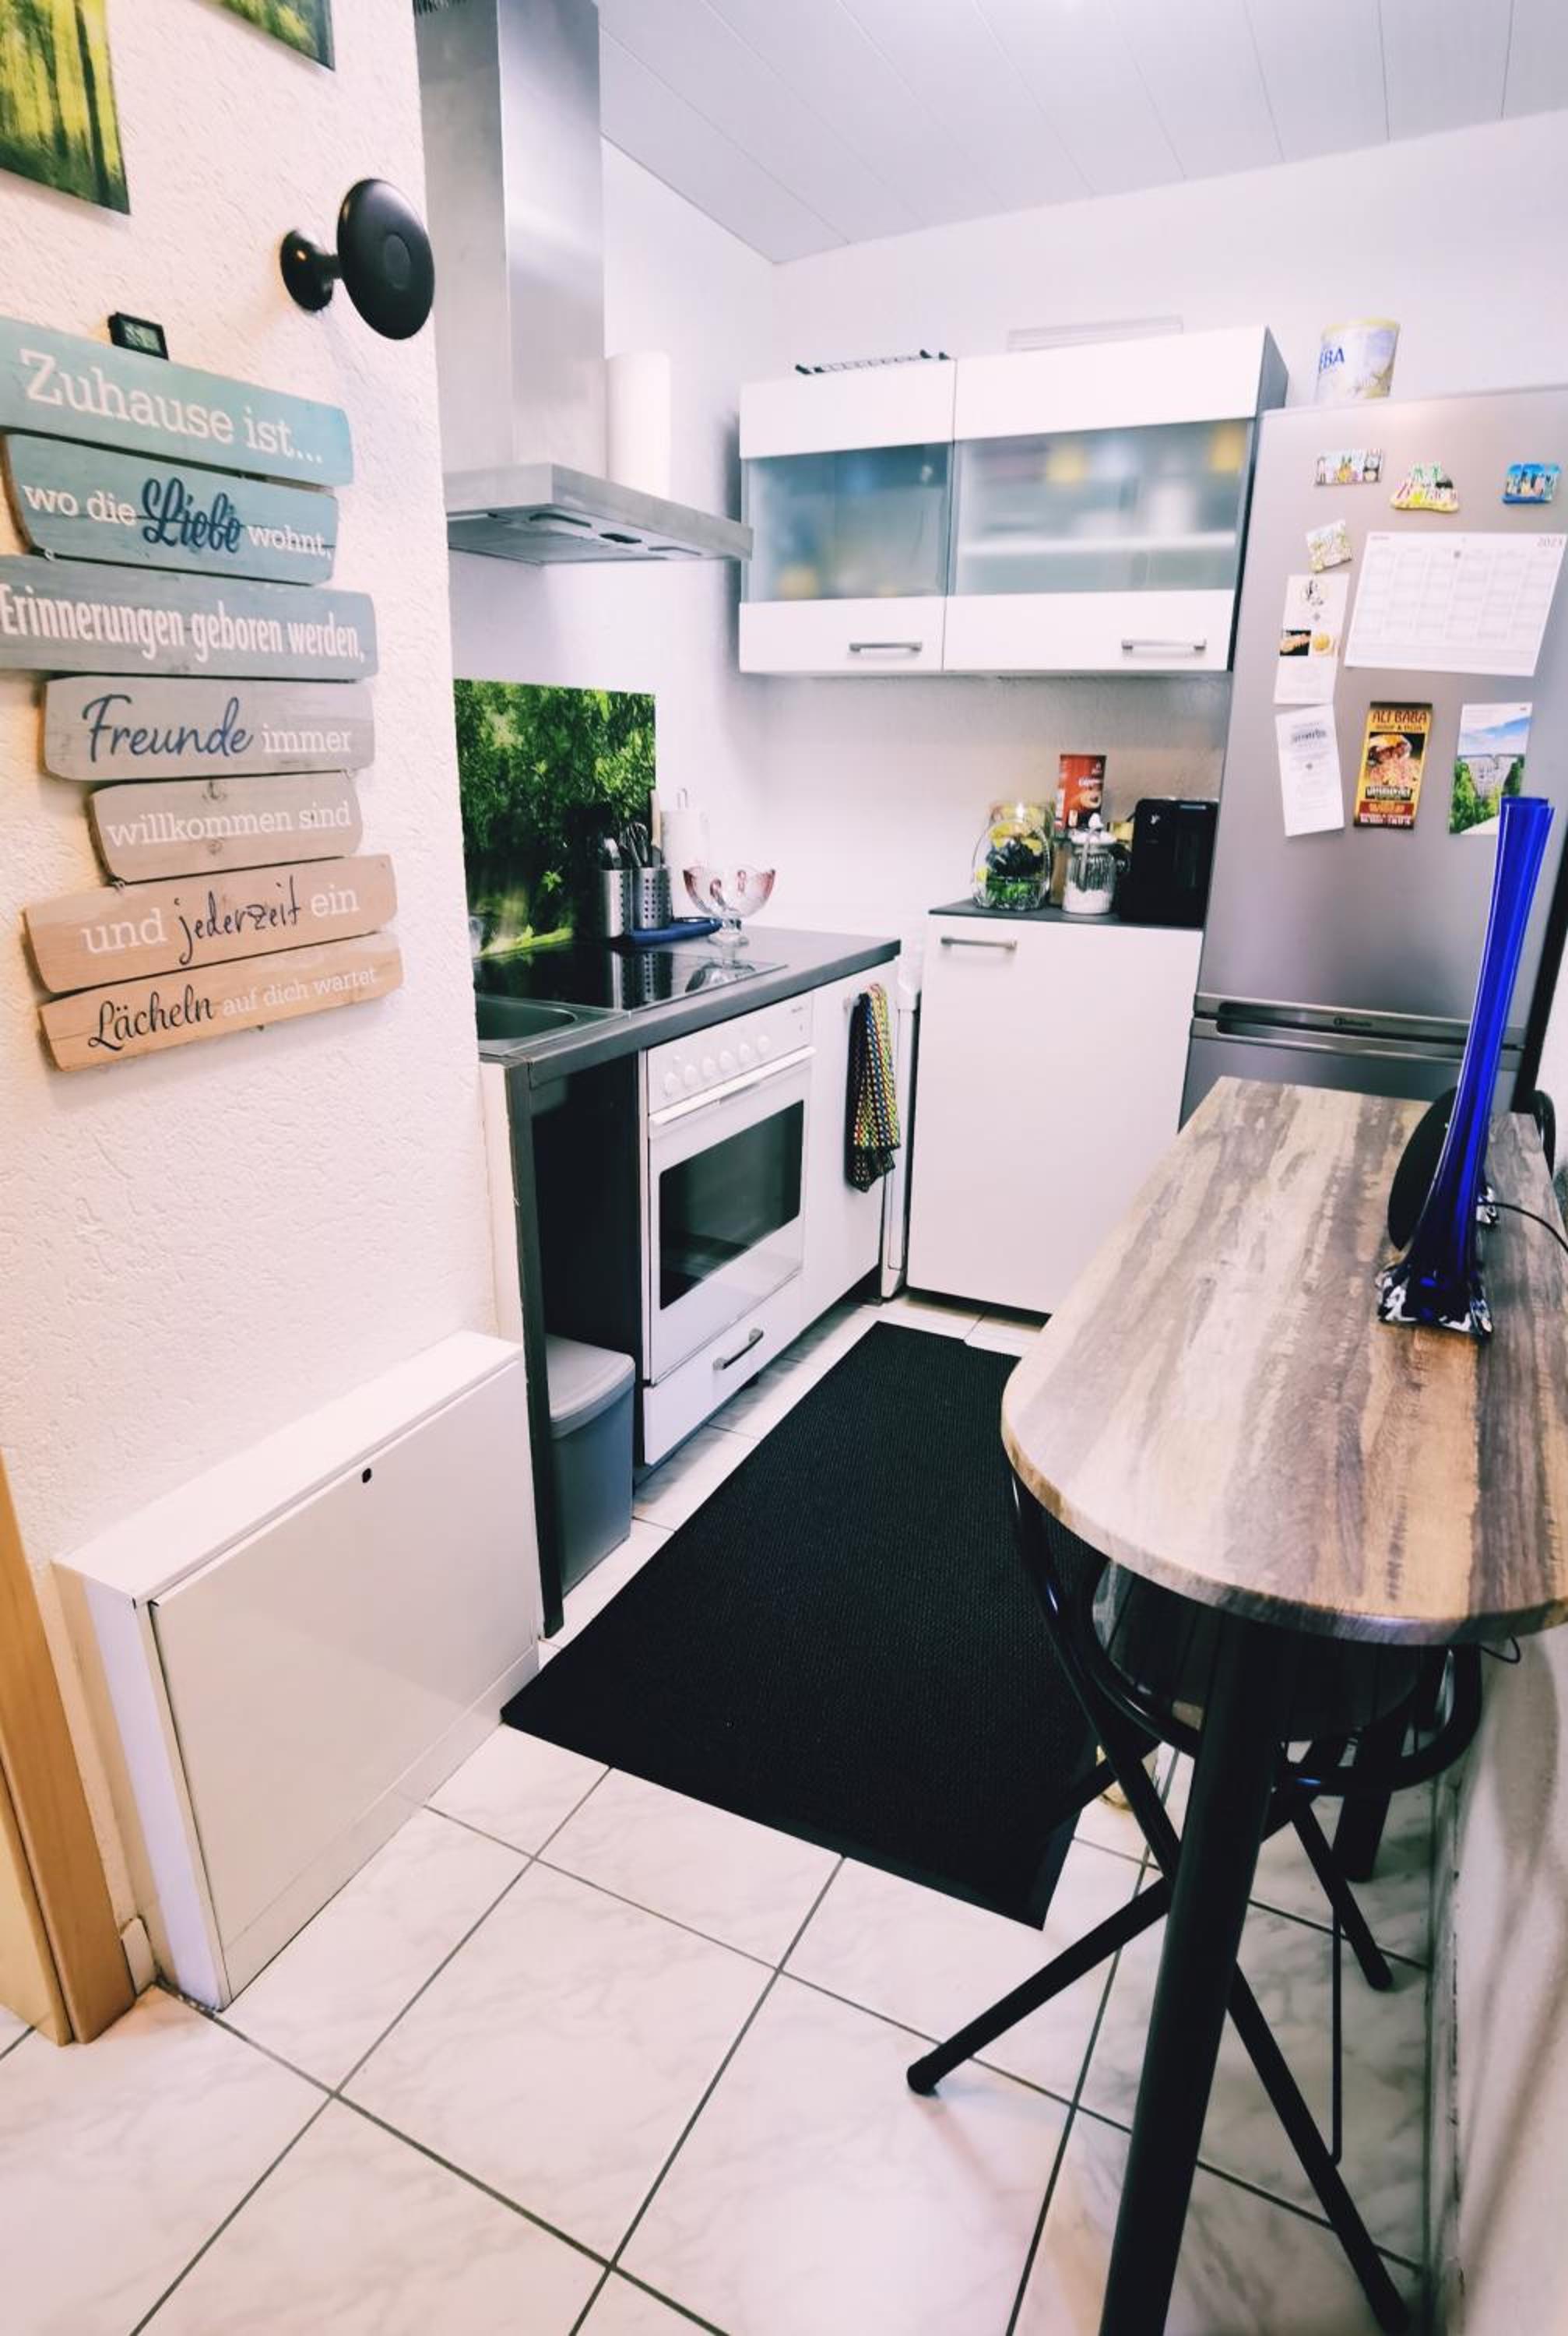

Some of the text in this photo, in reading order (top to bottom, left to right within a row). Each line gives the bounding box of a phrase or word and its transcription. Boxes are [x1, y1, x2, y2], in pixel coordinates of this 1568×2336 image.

[20, 350, 323, 463] Zuhause ist...
[21, 484, 78, 516] wo
[86, 490, 137, 526] die
[141, 477, 242, 554] Liebe
[0, 582, 365, 663] Erinnerungen geboren werden,
[82, 694, 352, 762] Freunde immer
[1372, 709, 1428, 723] ALI BABA
[106, 802, 352, 847] willkommen sind
[81, 875, 360, 966] und jederzeit ein
[87, 966, 377, 1051] Lächeln auf dich wartet
